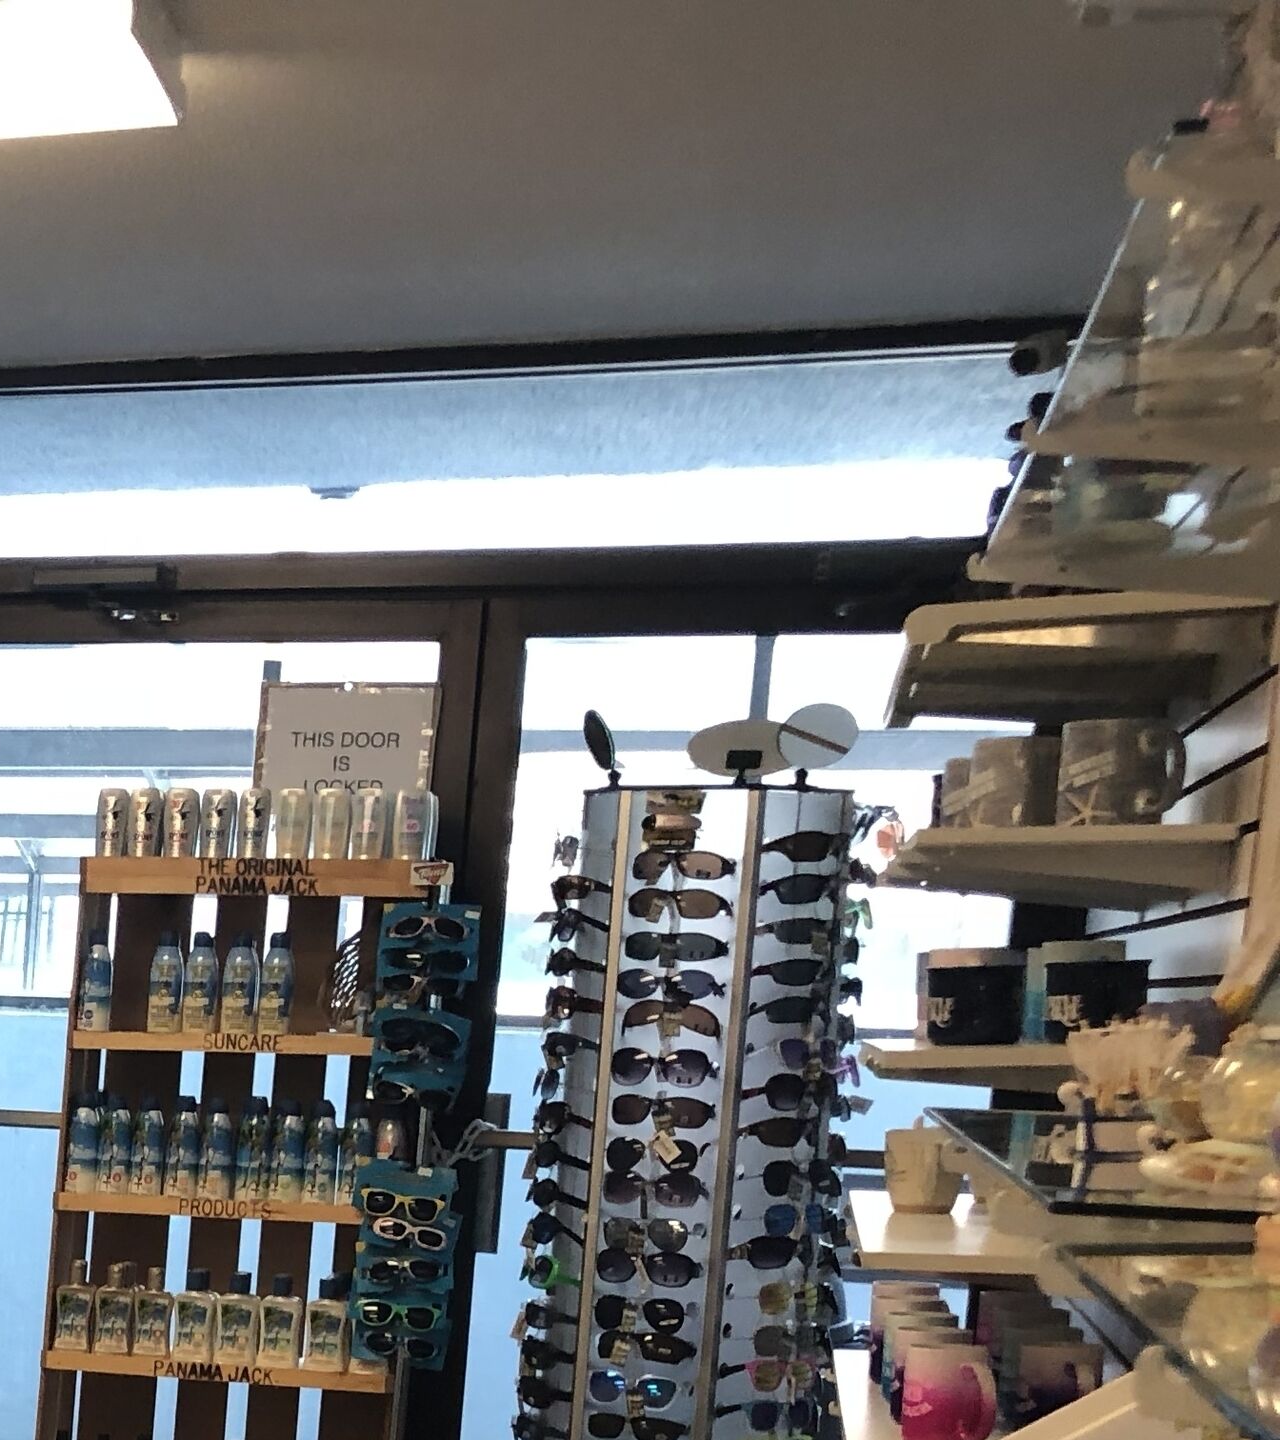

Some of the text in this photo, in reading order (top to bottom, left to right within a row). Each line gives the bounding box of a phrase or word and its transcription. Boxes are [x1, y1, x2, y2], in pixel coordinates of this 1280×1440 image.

[291, 731, 400, 748] THIS DOOR
[333, 756, 350, 772] IS
[198, 857, 314, 877] THE ORIGINAL
[195, 876, 320, 897] PANAMA JACK
[203, 1031, 284, 1052] SUNCARE
[179, 1199, 273, 1219] PRODUCTS
[153, 1360, 274, 1384] PANAMA JACK
